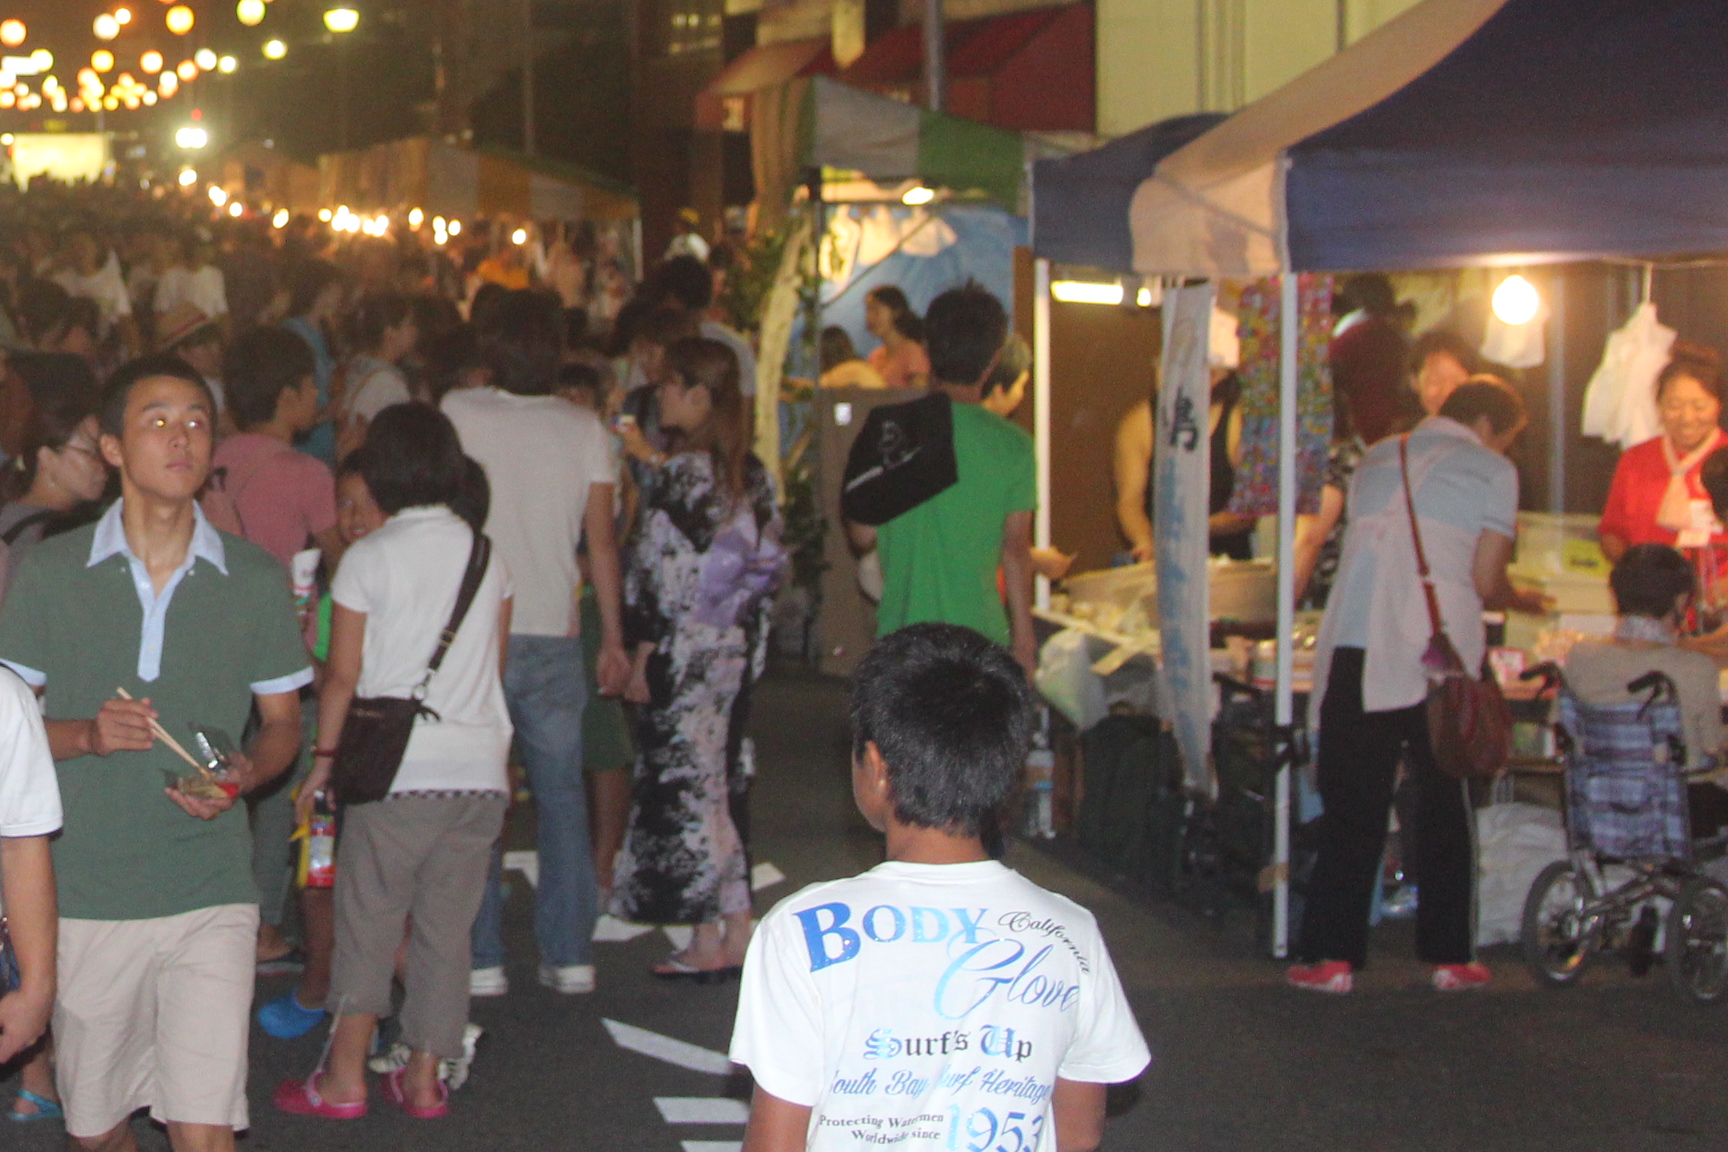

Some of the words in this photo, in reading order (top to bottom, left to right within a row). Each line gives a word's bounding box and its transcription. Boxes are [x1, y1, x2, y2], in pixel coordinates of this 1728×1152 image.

[792, 902, 989, 972] BODY
[997, 911, 1090, 974] California
[933, 928, 1080, 1020] Glove
[863, 1028, 971, 1060] Surf's
[979, 1024, 1033, 1063] Up
[829, 1068, 878, 1095] outh
[884, 1069, 930, 1100] Bay
[819, 1114, 884, 1129] Protecting
[911, 1127, 941, 1140] since
